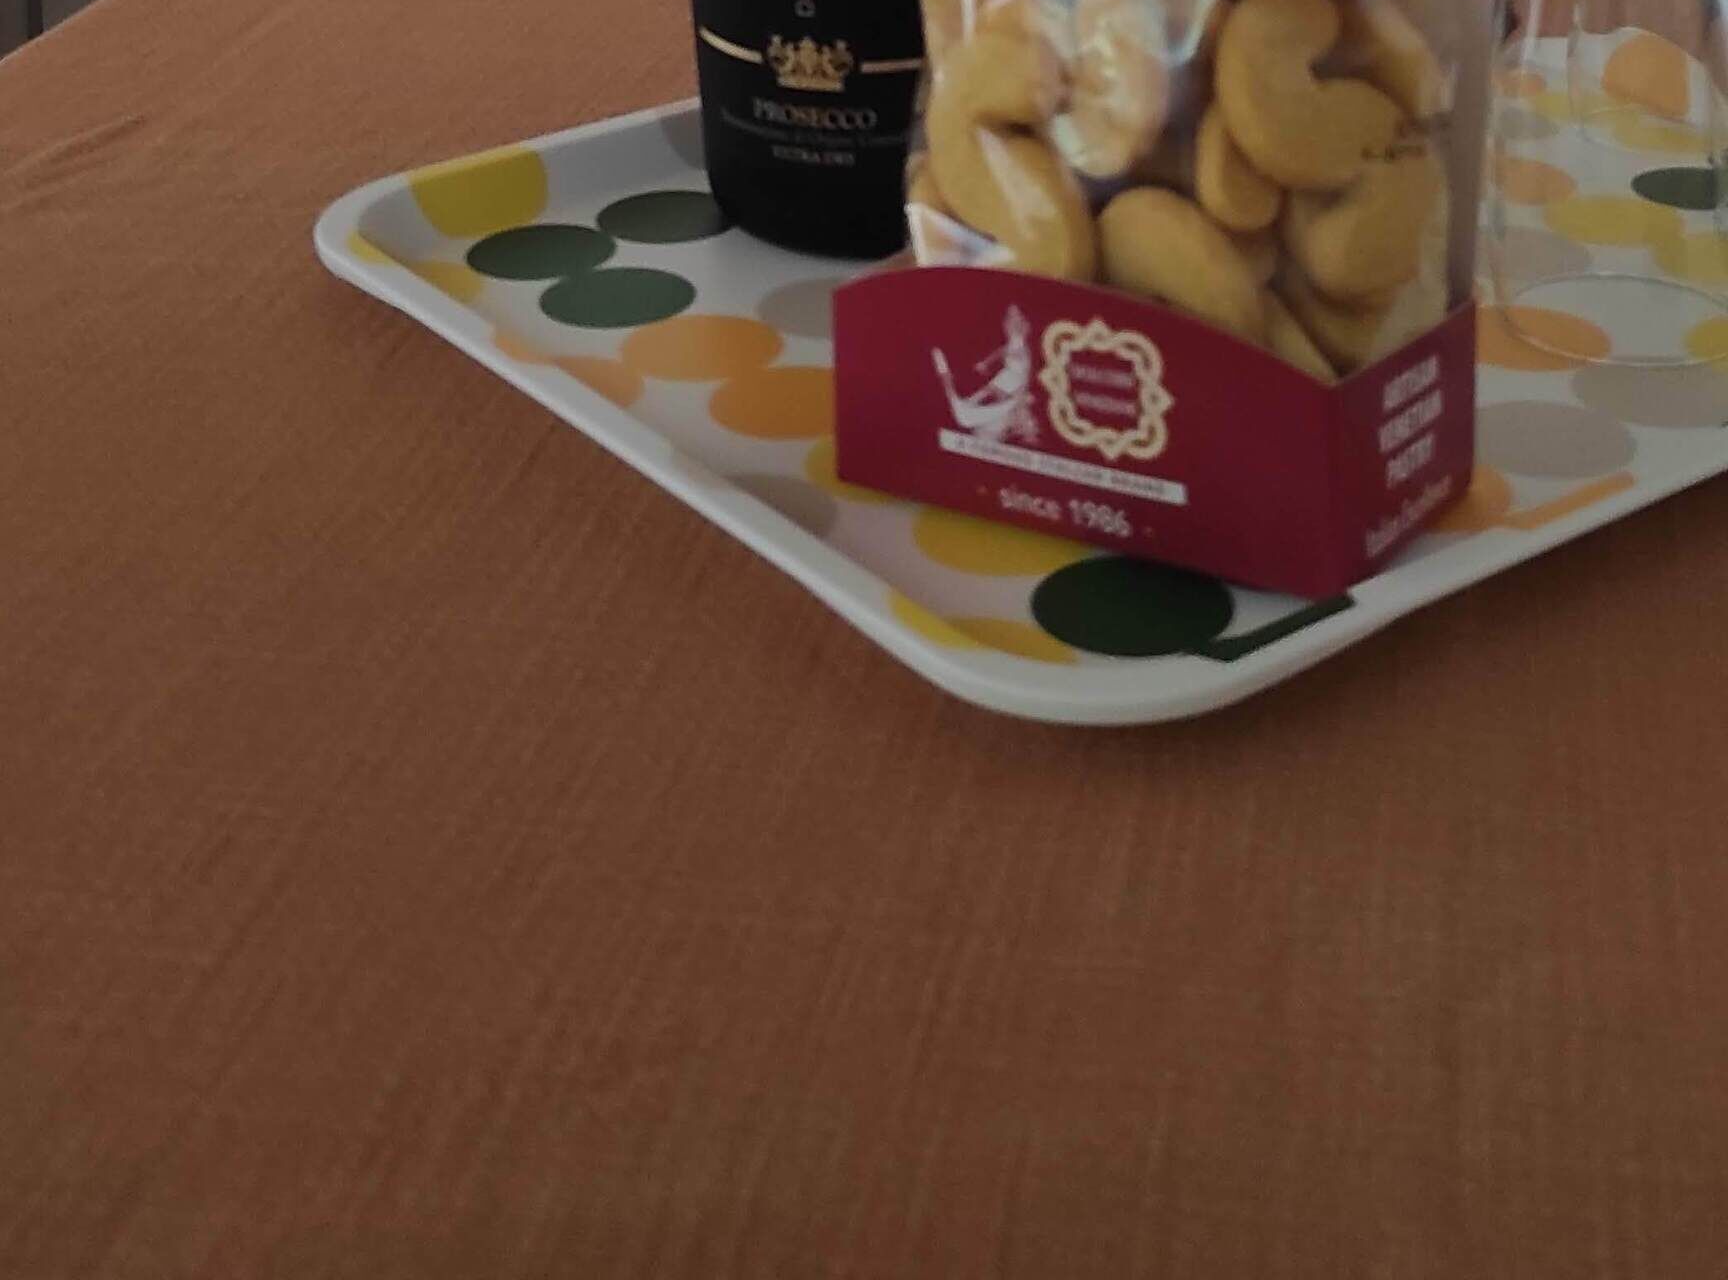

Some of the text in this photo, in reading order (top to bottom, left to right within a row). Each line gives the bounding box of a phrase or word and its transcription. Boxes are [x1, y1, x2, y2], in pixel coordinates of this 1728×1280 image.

[753, 97, 879, 130] PROSECCO
[999, 484, 1132, 538] since 1986
